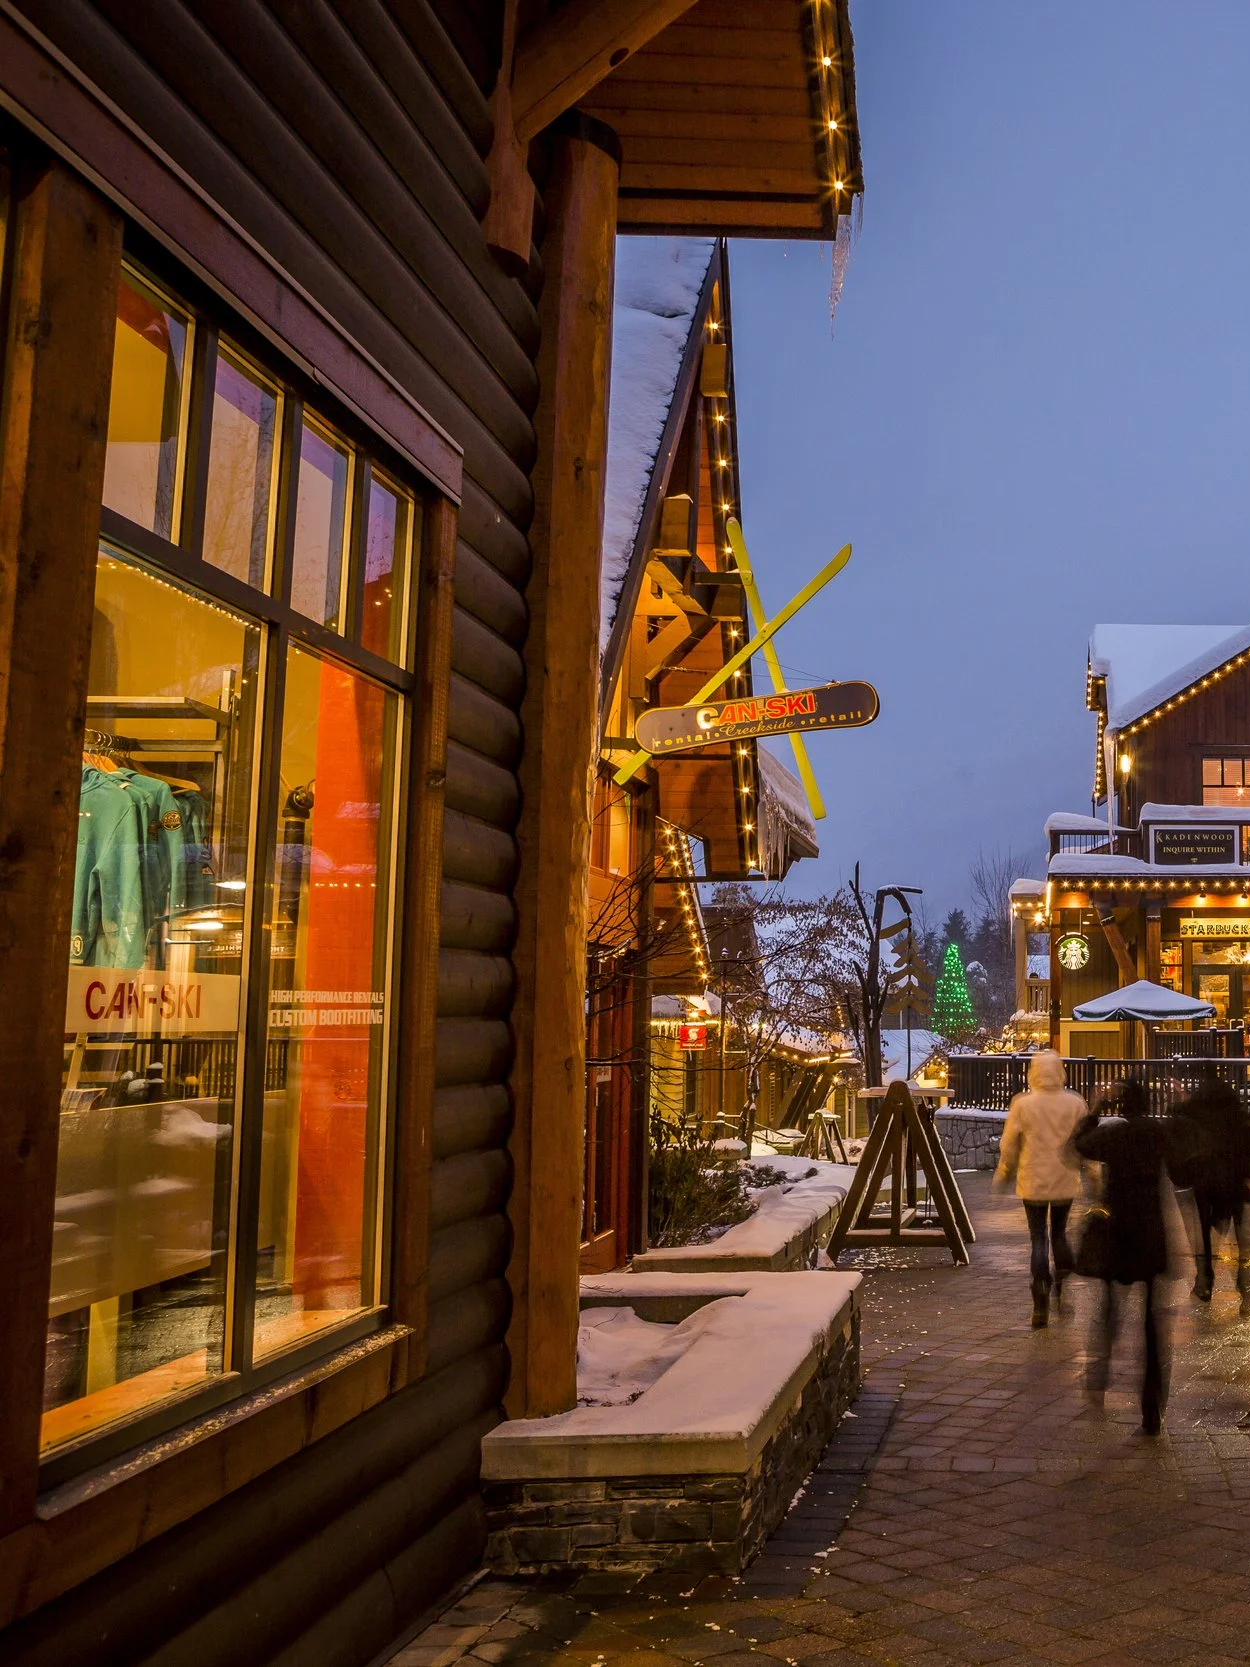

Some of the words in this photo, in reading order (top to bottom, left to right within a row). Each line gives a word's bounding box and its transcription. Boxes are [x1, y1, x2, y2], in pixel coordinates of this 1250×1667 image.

[696, 693, 816, 729] CAN-SKI
[653, 731, 711, 748] rental
[720, 719, 795, 737] Creekside
[810, 711, 862, 725] retail
[85, 981, 201, 1020] CAN-SKI
[270, 990, 293, 1003] HIGH
[294, 990, 352, 1003] PERFORMANCE
[353, 992, 384, 1003] RENTALS
[269, 1009, 317, 1027] CUSTOM
[320, 1009, 383, 1025] BOOTFITTING
